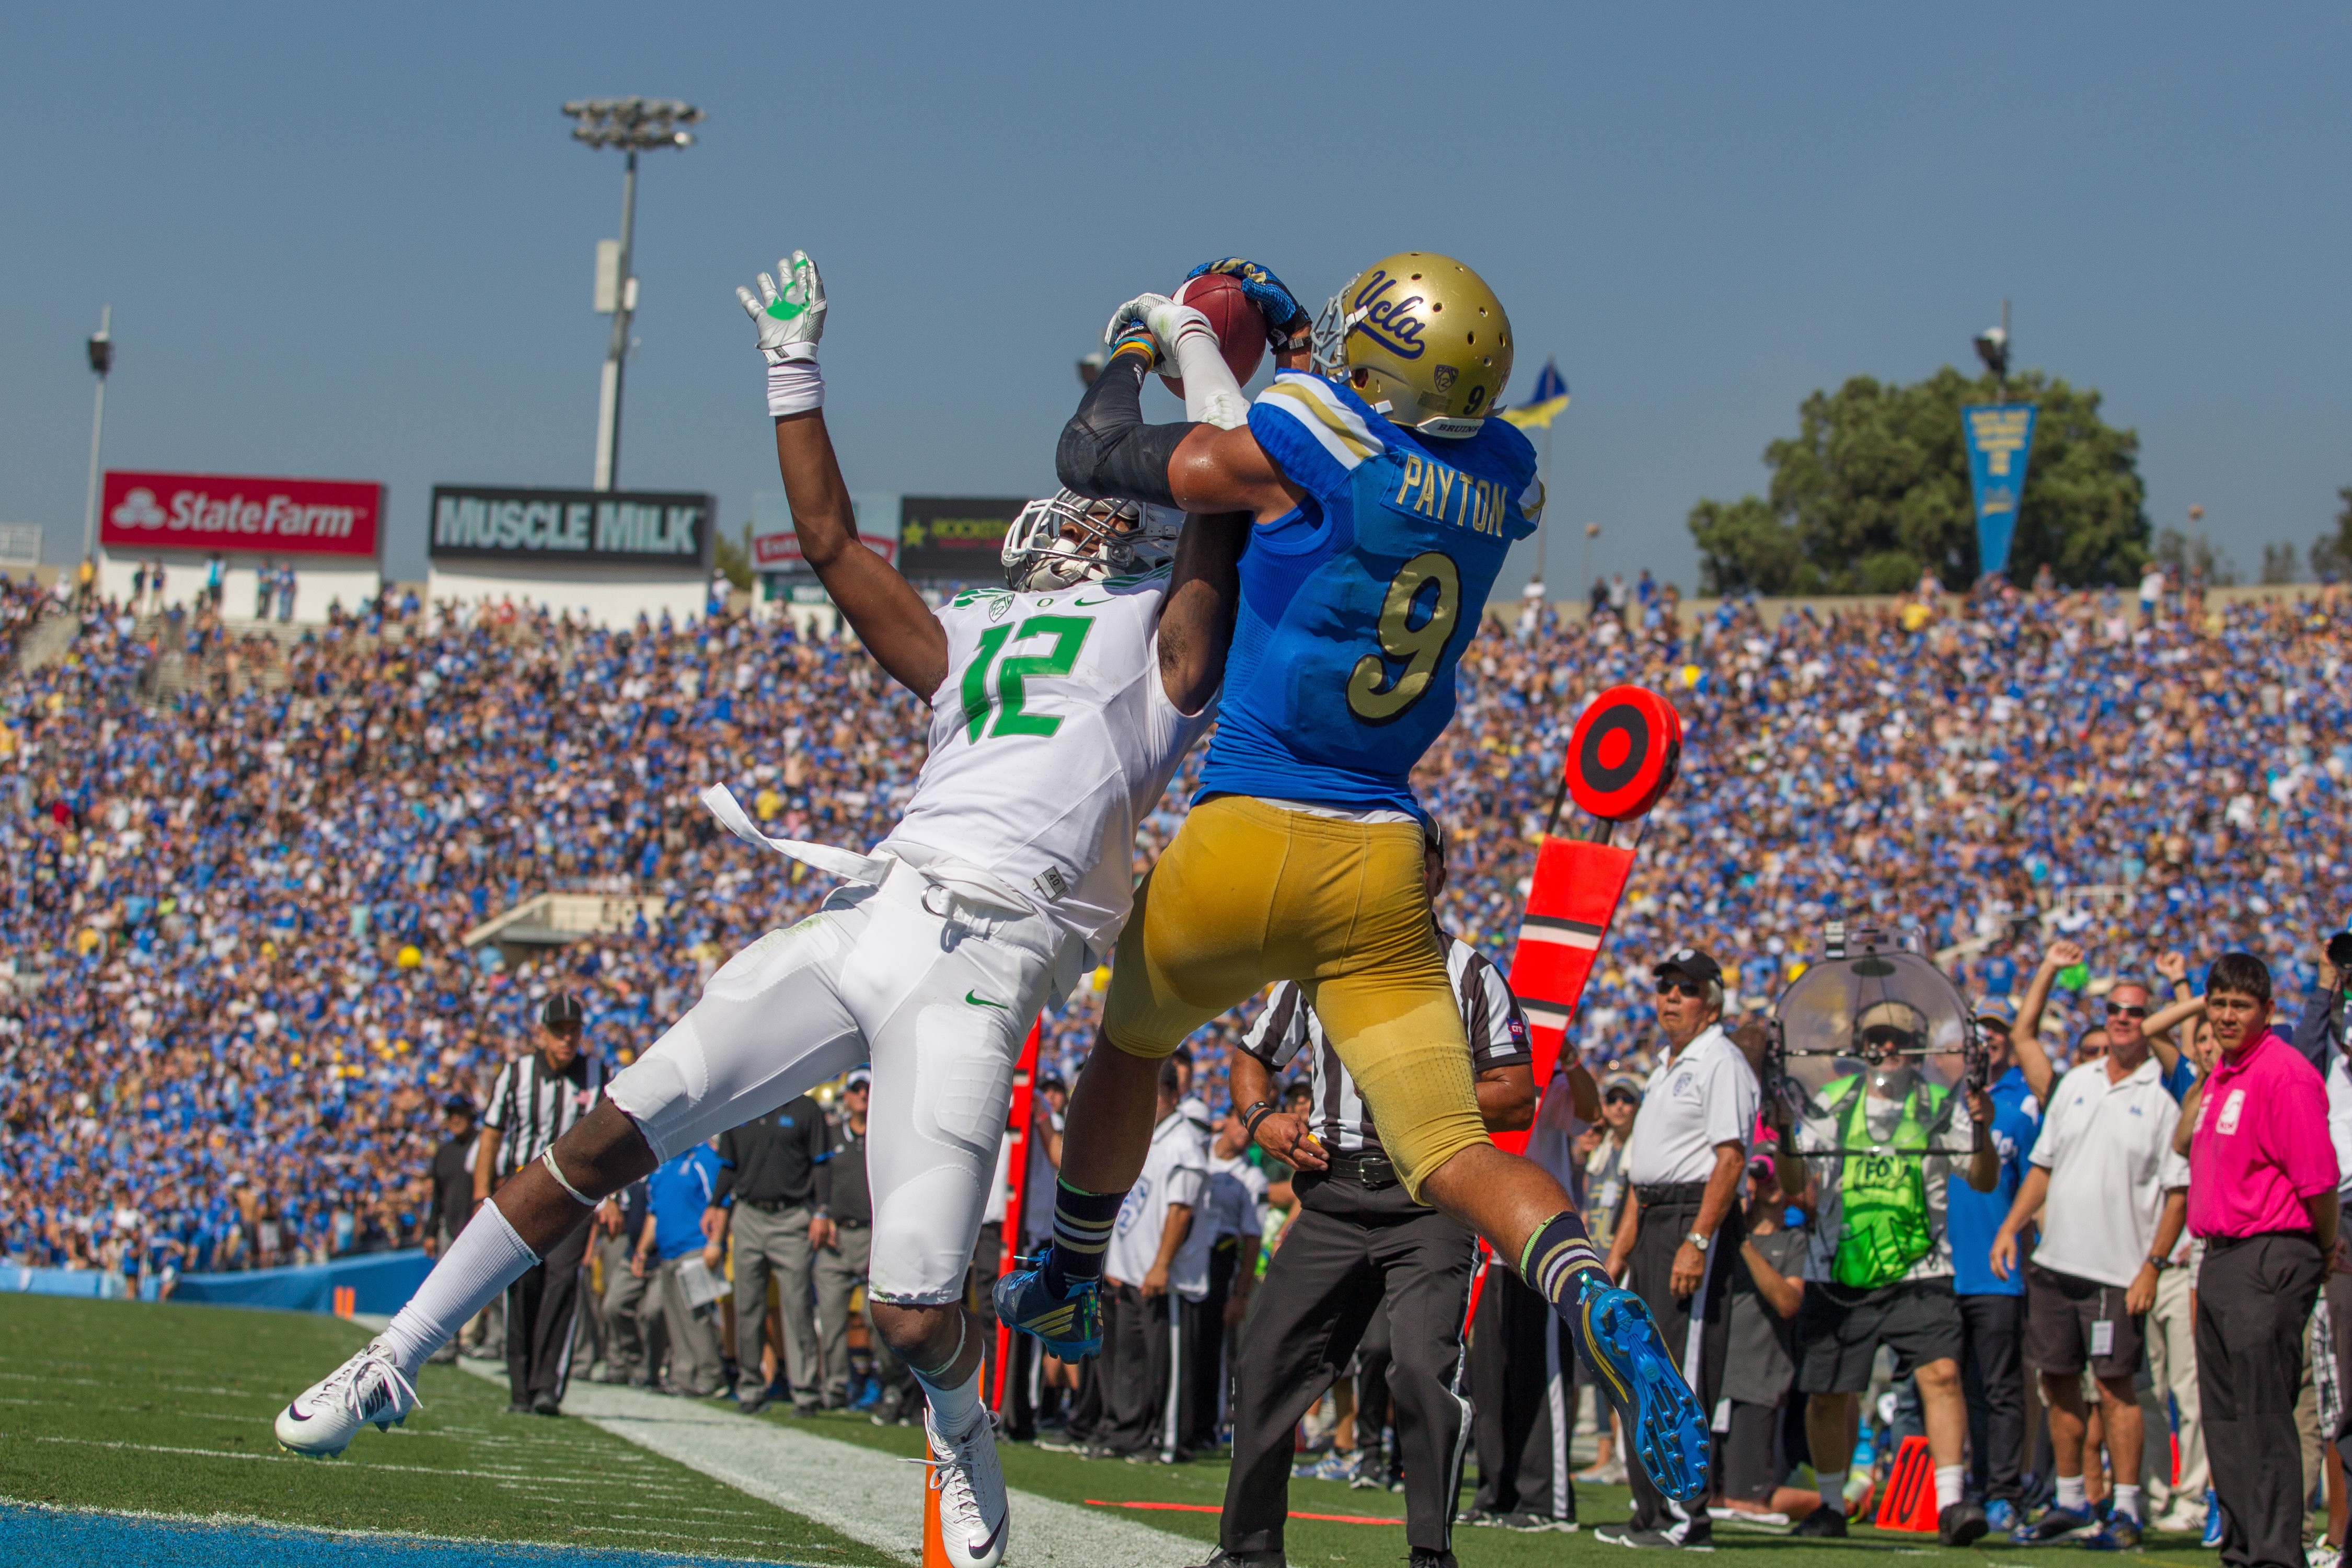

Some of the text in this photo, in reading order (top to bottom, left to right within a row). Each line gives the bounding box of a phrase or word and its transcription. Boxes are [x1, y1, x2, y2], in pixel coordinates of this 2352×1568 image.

[1438, 423, 1479, 433] BRUINS
[1464, 385, 1485, 415] 9
[434, 496, 697, 555] MUSCLE MILK
[1396, 453, 1508, 537] PAYTON
[1345, 550, 1462, 727] 9
[960, 613, 1097, 746] 12
[1049, 874, 1060, 886] 40
[1886, 1444, 1931, 1524] 10
